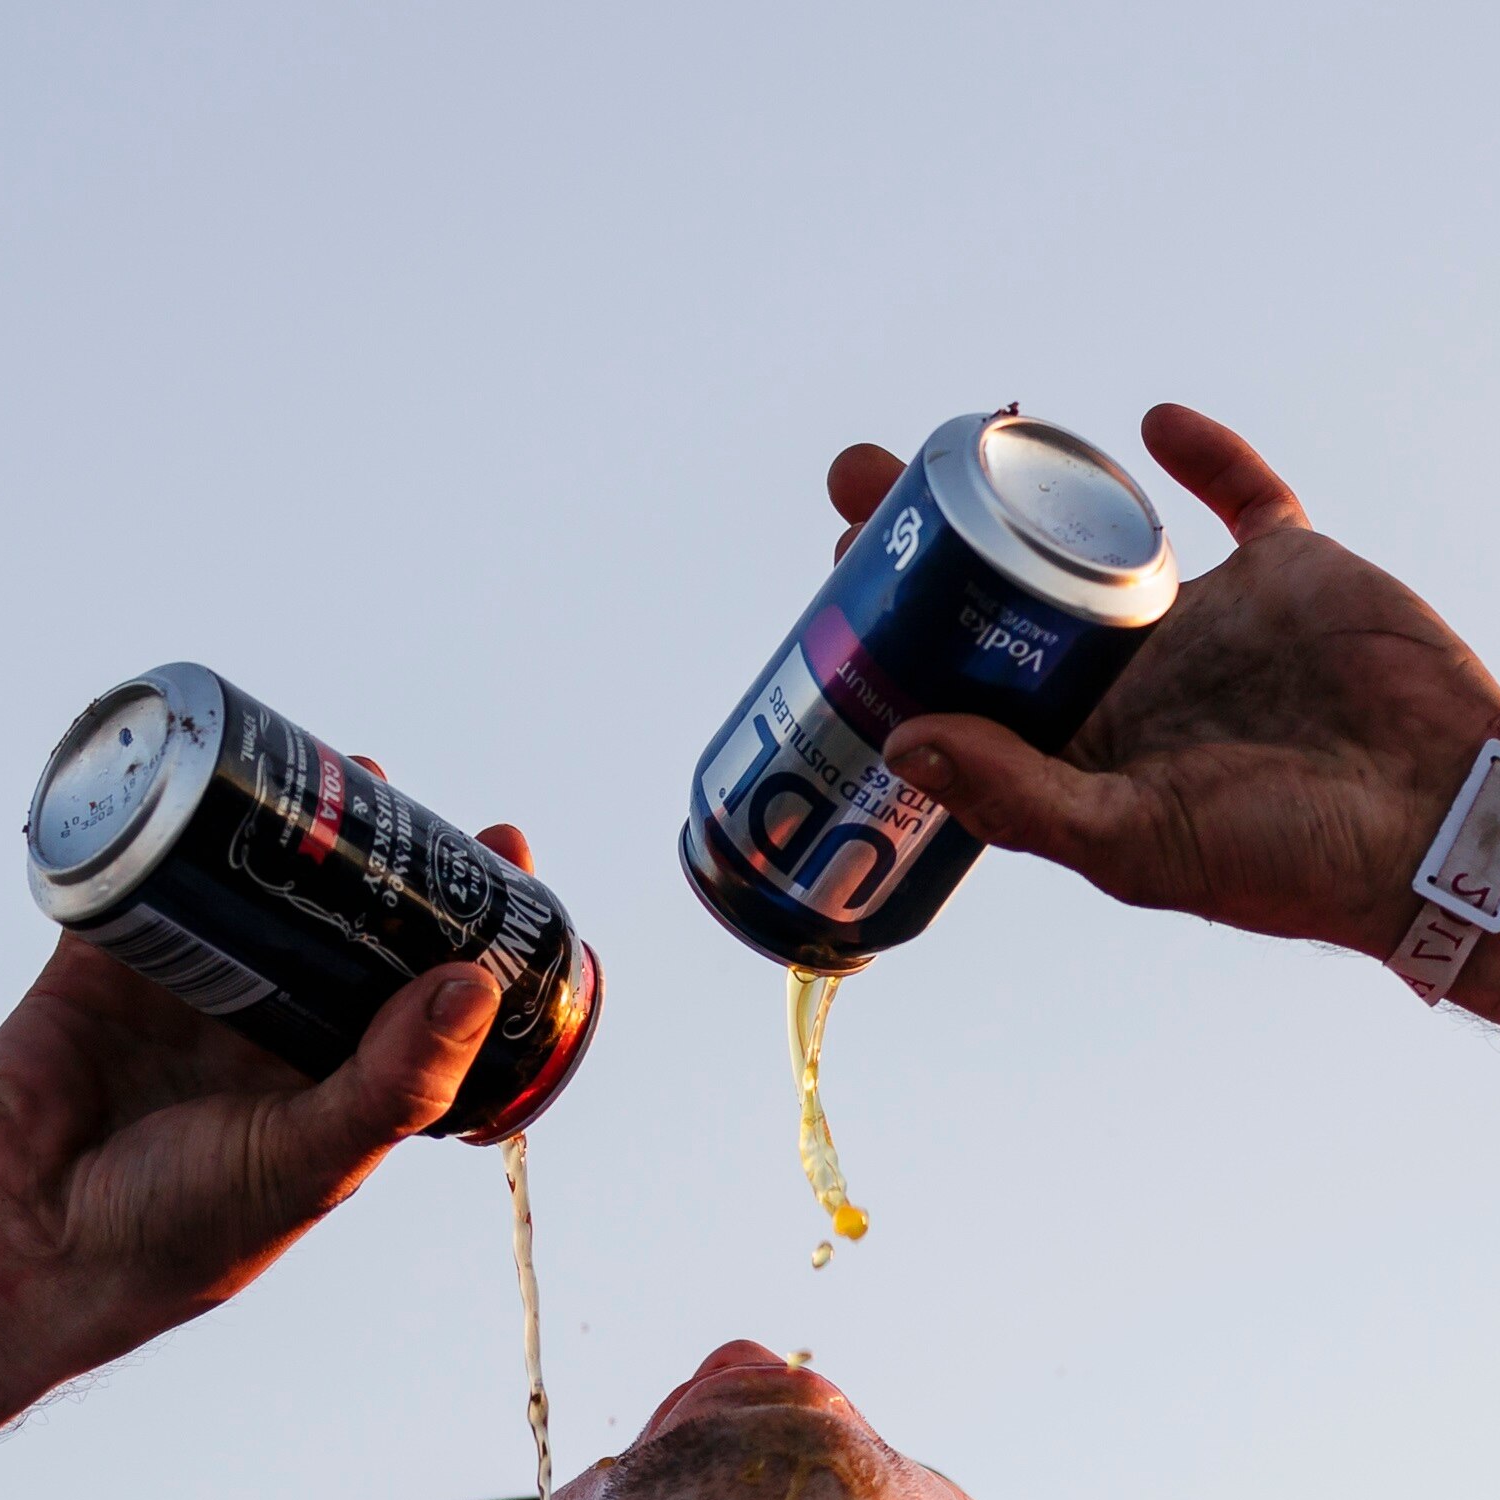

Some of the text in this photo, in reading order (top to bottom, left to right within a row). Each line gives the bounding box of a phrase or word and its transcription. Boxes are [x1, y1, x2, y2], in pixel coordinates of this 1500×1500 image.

[959, 605, 1044, 673] Vodka
[835, 660, 902, 728] NFRUIT
[318, 760, 342, 821] COLA
[768, 685, 923, 835] UNITED DISTILLERS
[859, 764, 890, 796] '65
[352, 795, 369, 816] &
[722, 713, 897, 910] UDL
